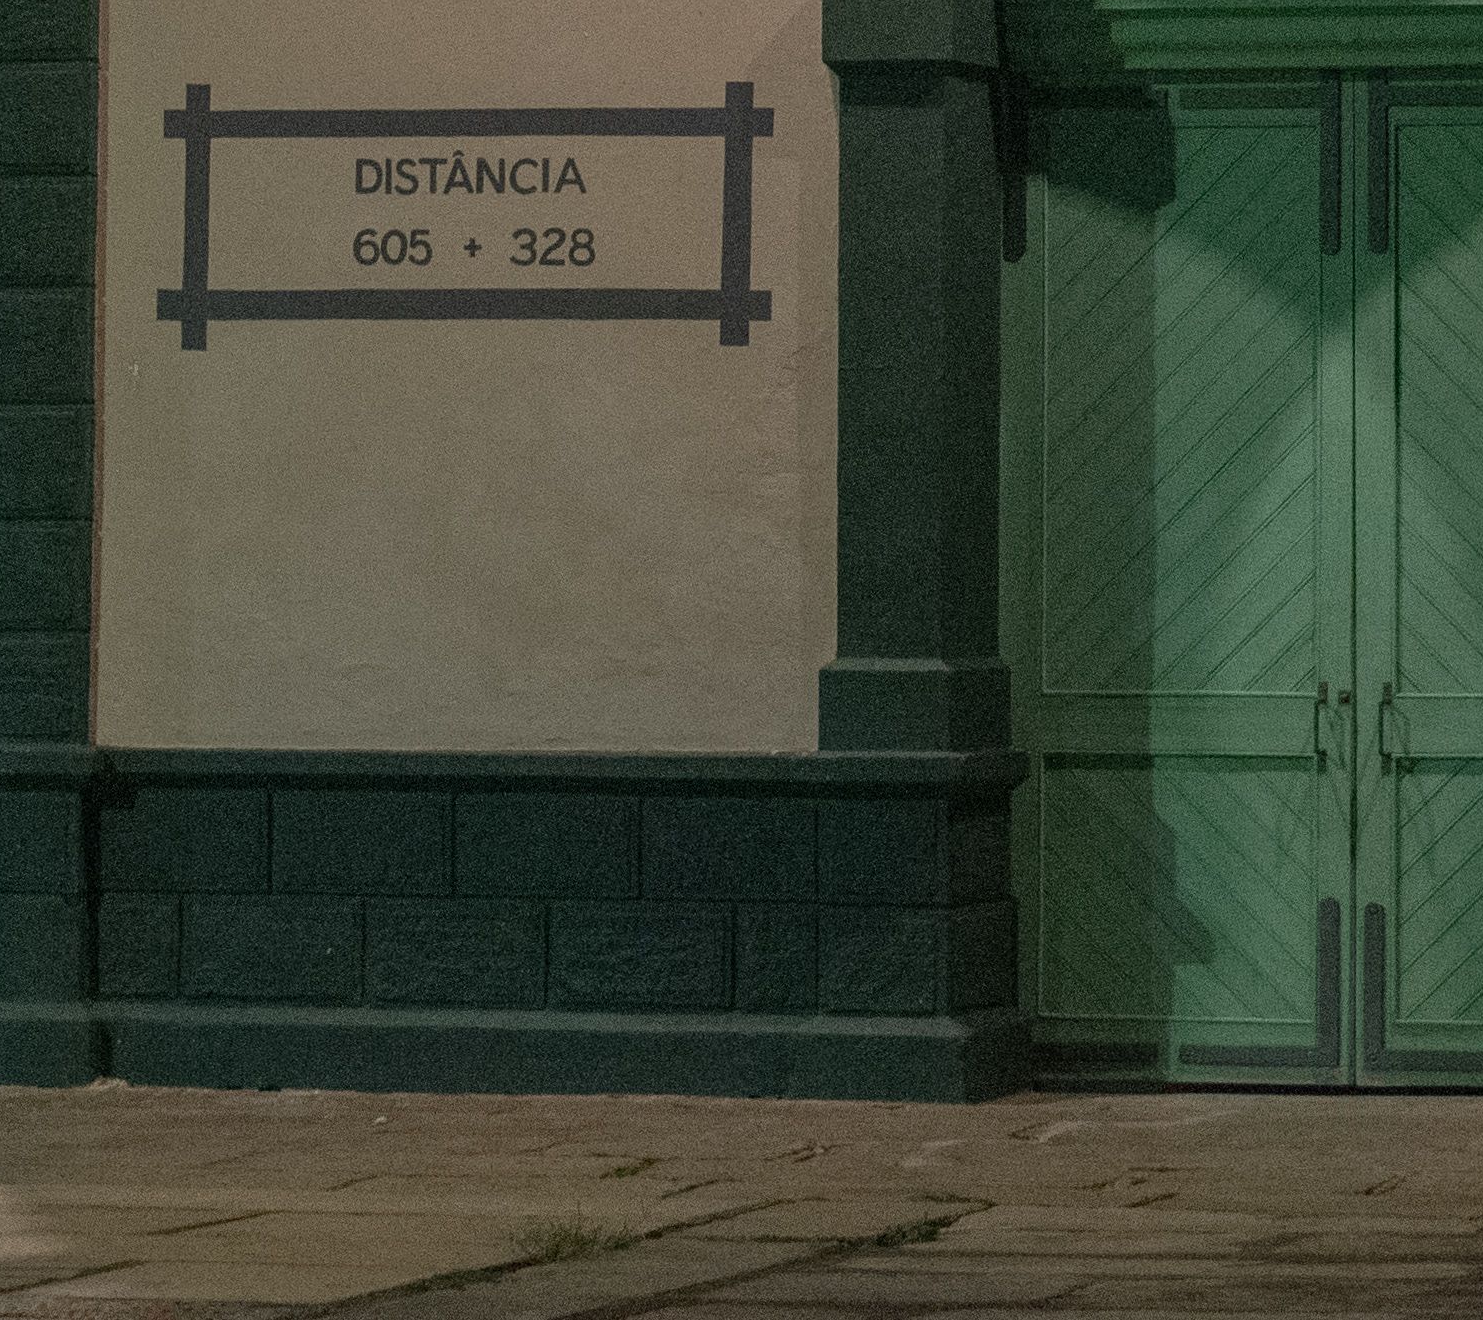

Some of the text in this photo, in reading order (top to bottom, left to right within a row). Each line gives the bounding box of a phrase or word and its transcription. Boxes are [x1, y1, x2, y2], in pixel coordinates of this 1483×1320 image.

[354, 150, 587, 196] DISTÂNCIA
[352, 227, 596, 267] 605 + 328
